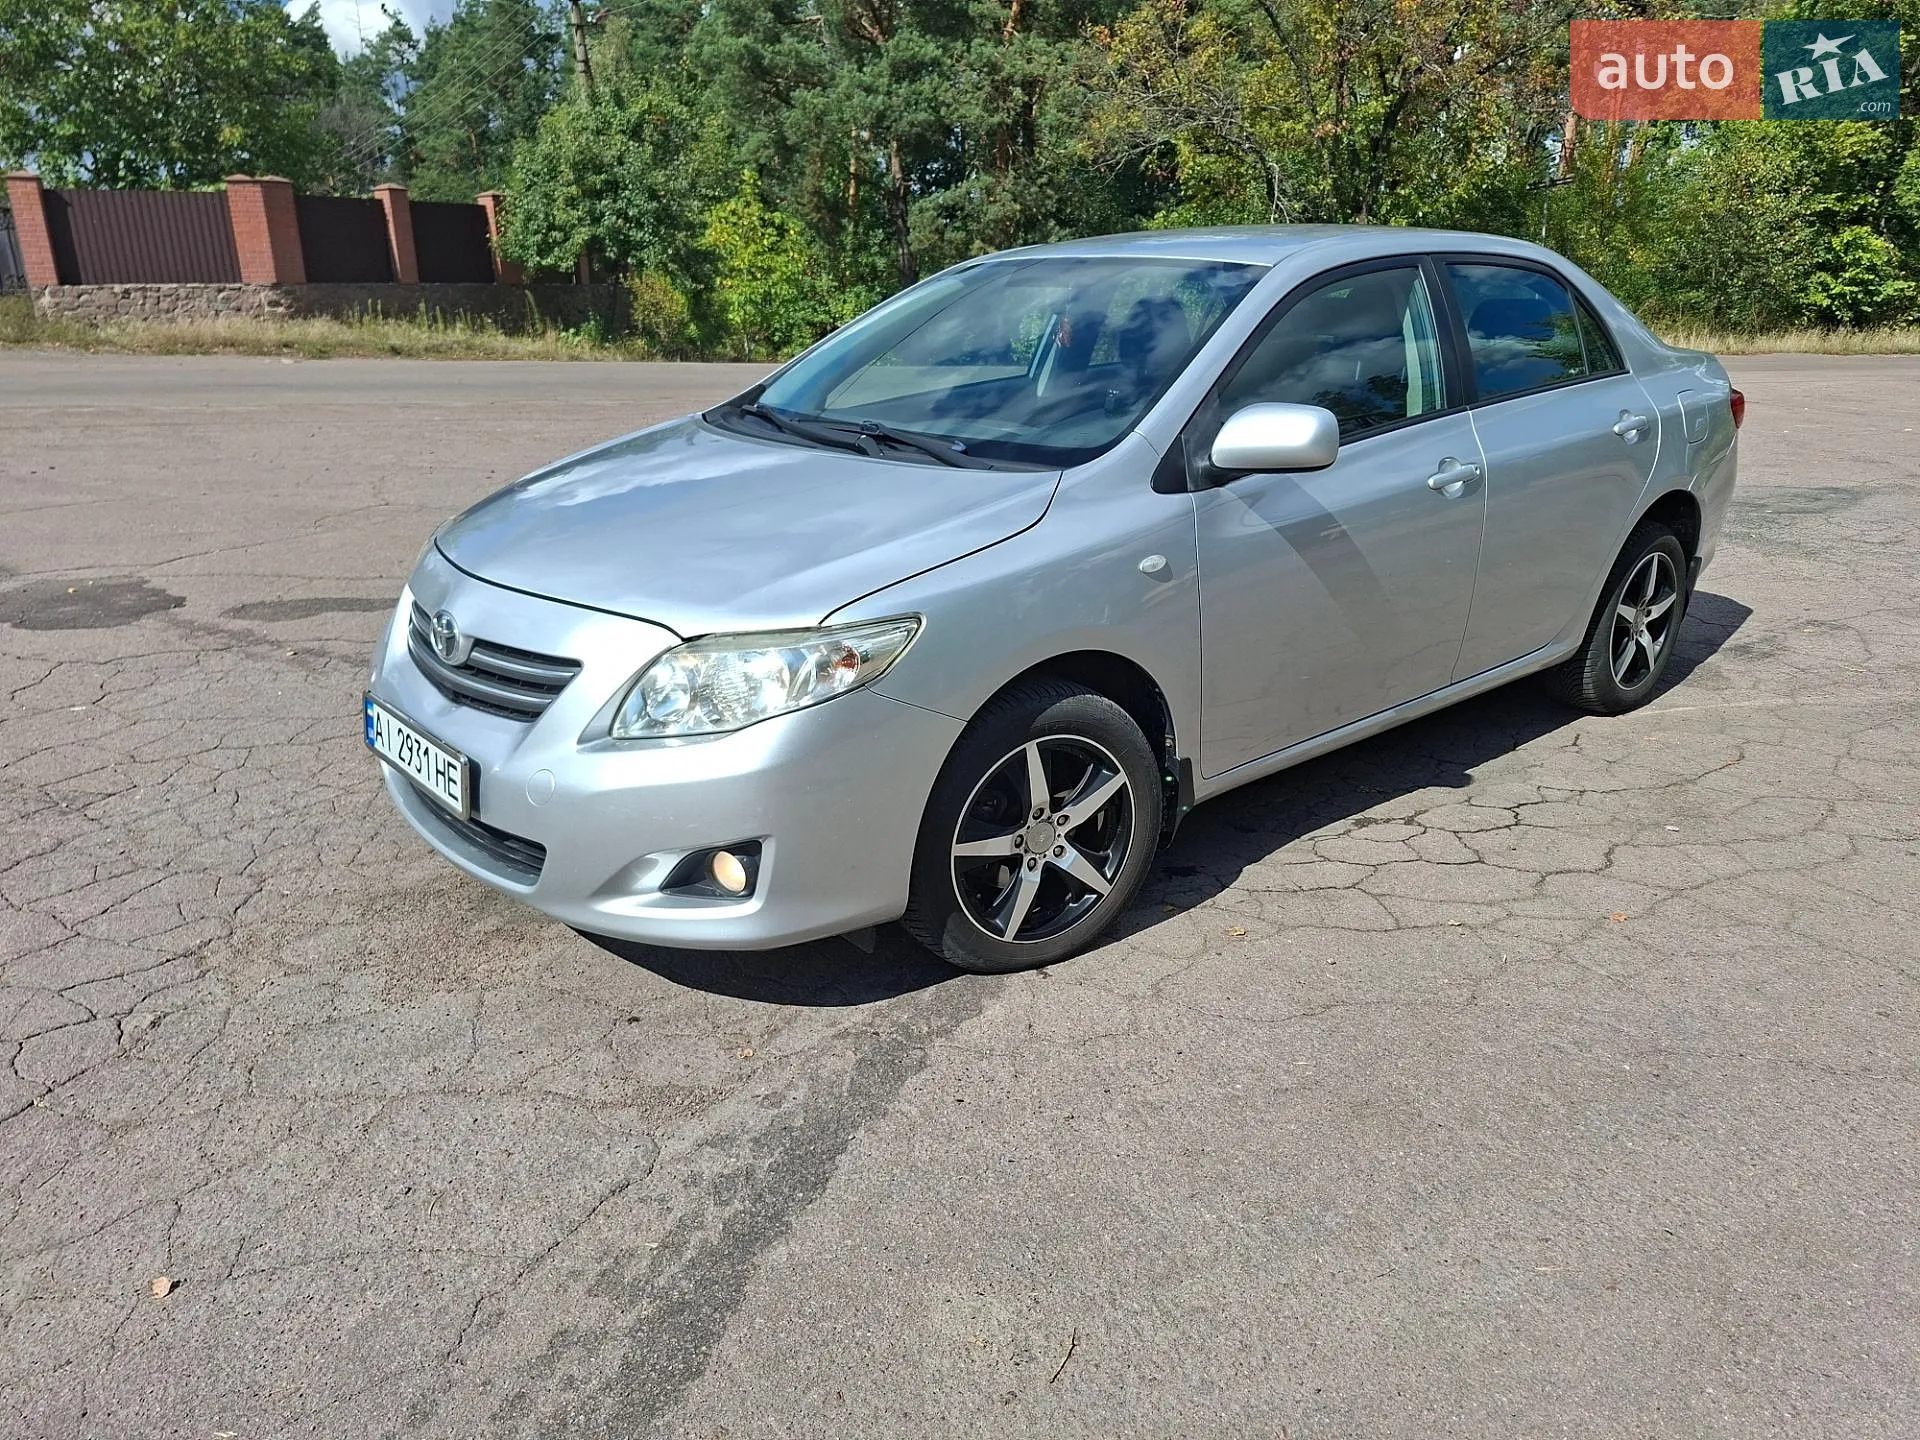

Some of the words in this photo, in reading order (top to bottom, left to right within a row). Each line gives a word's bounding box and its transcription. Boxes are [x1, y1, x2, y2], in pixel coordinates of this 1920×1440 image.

[375, 711, 391, 752] AI
[397, 727, 430, 782] 2931
[435, 752, 459, 802] HE
